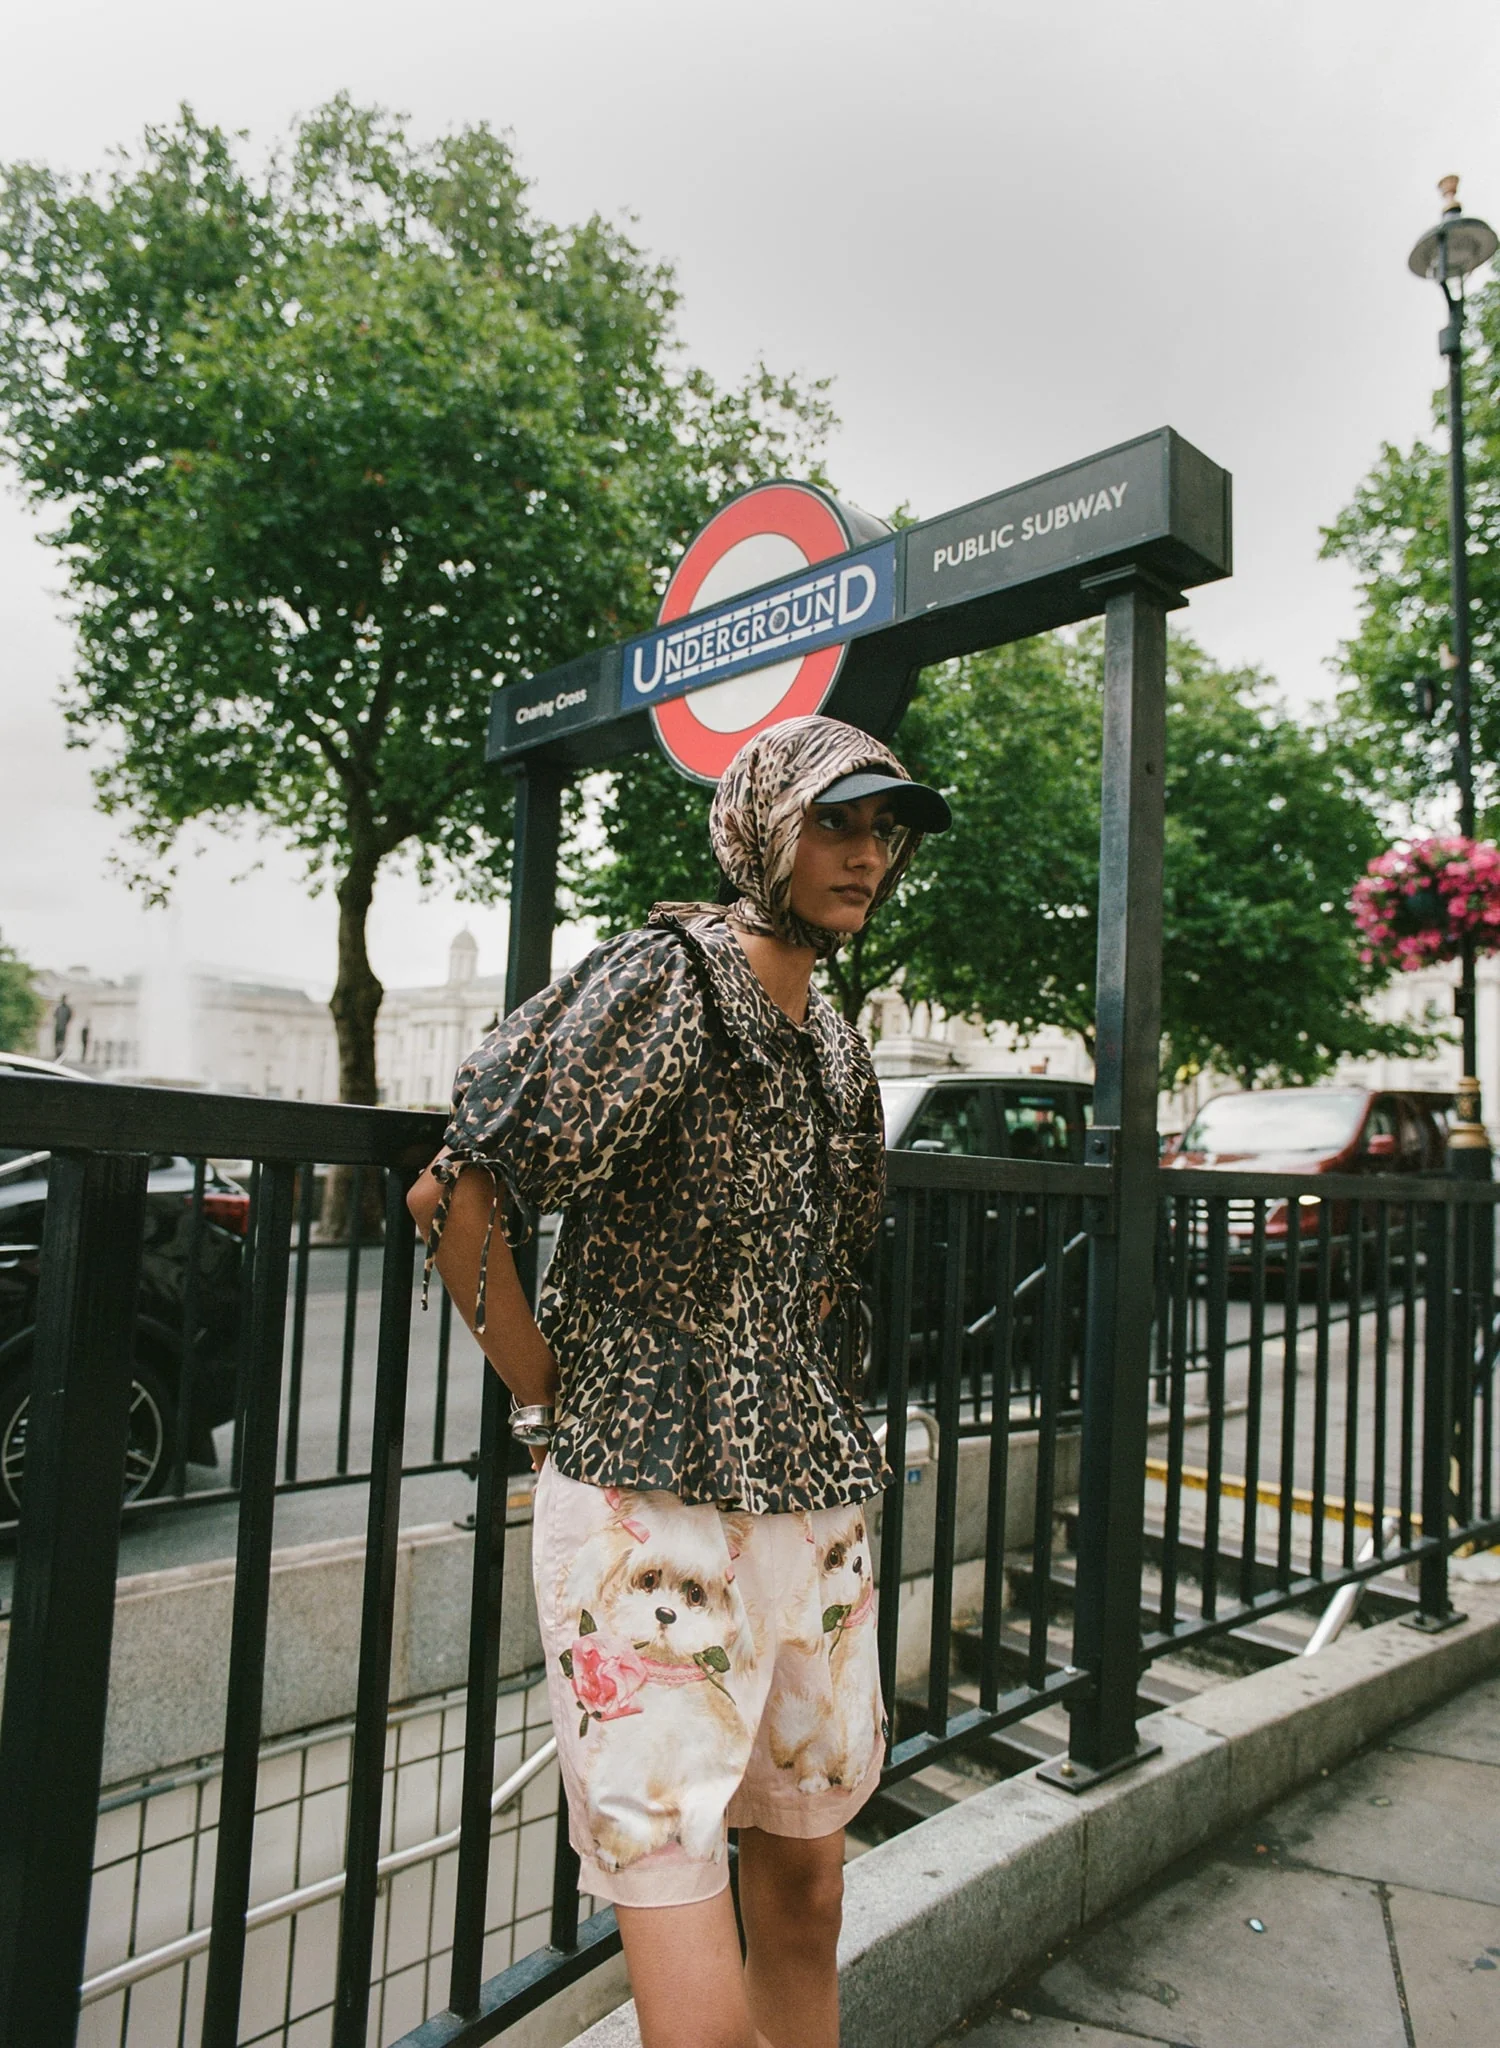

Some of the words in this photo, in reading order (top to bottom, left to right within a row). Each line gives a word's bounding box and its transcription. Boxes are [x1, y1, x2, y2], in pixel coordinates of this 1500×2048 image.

[933, 524, 1014, 572] PUBLIC
[1021, 481, 1128, 541] SUBWAY
[633, 564, 877, 694] UNDERGROUND
[515, 700, 555, 725] Charing
[555, 688, 588, 711] Cross
